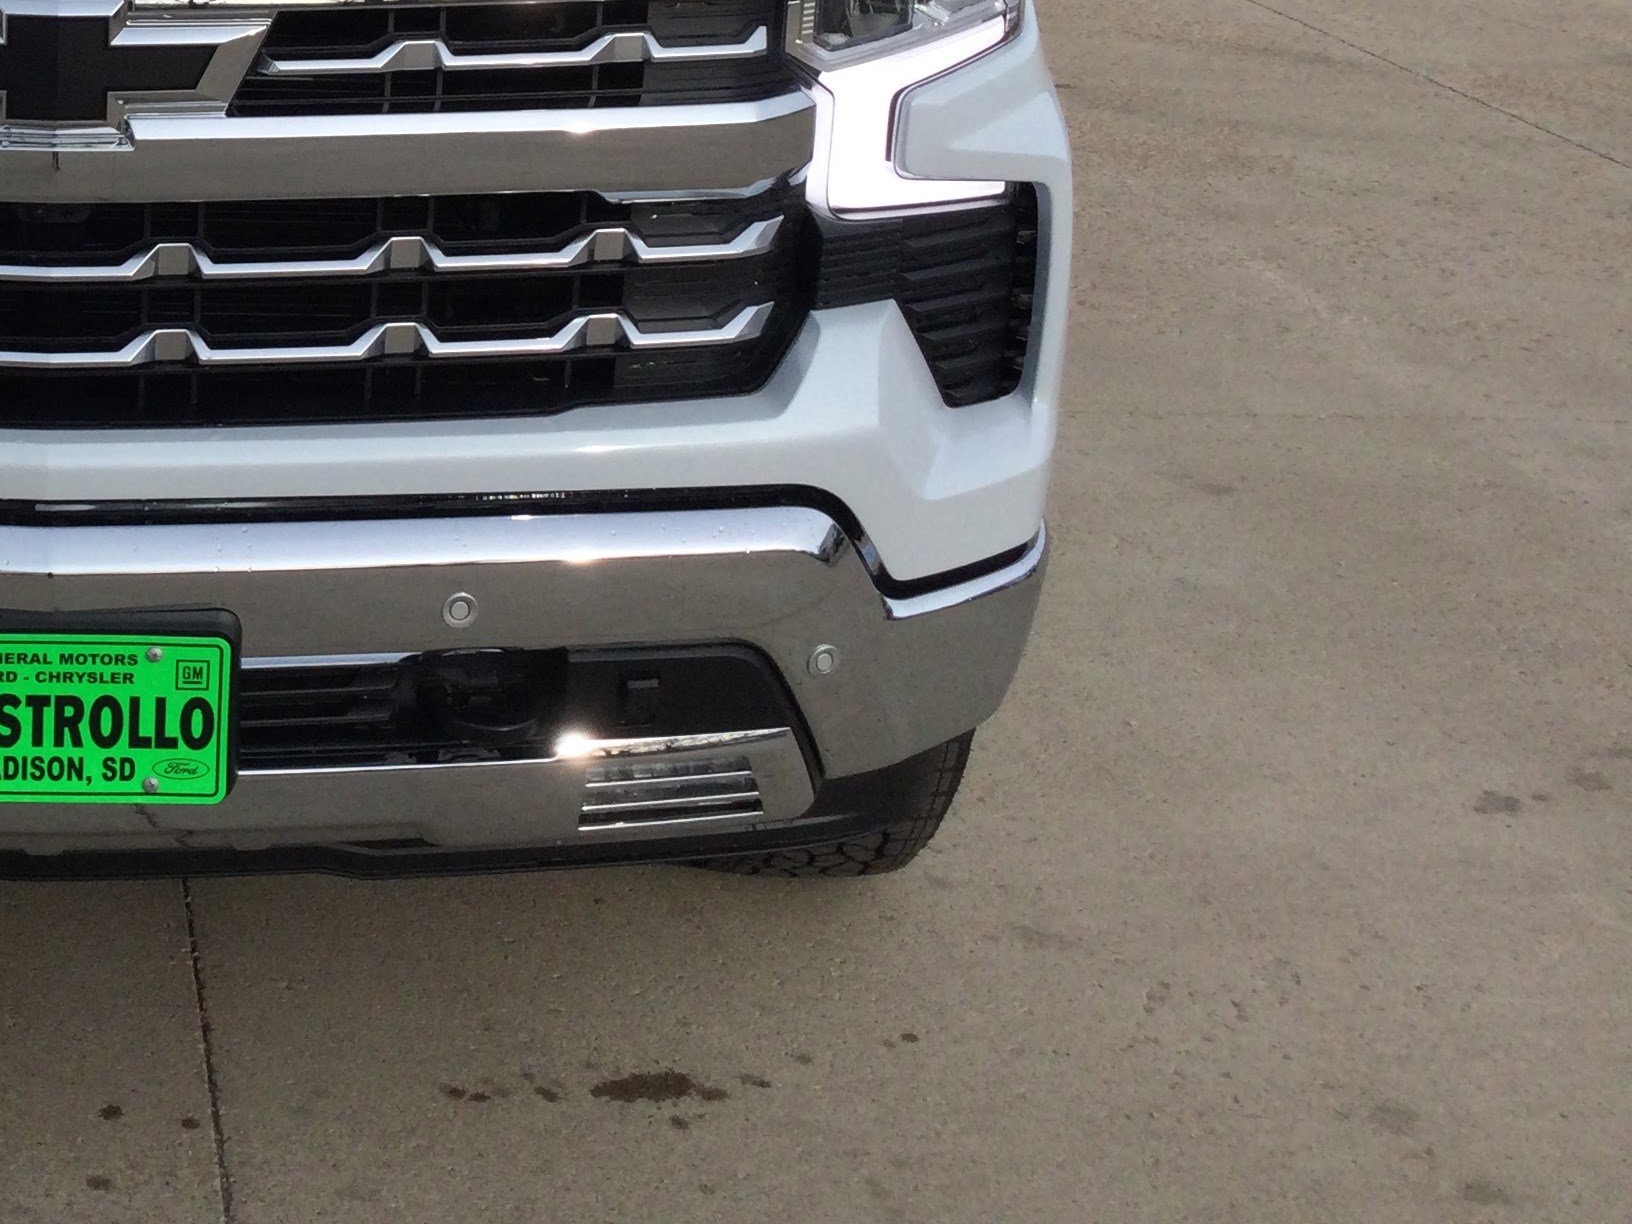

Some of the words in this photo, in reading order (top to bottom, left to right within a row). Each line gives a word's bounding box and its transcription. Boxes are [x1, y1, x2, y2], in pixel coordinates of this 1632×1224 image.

[58, 652, 139, 667] MOTORS
[37, 671, 135, 685] CHRYSLER
[182, 666, 204, 680] GM
[101, 756, 136, 782] SD
[163, 761, 199, 776] Ford
